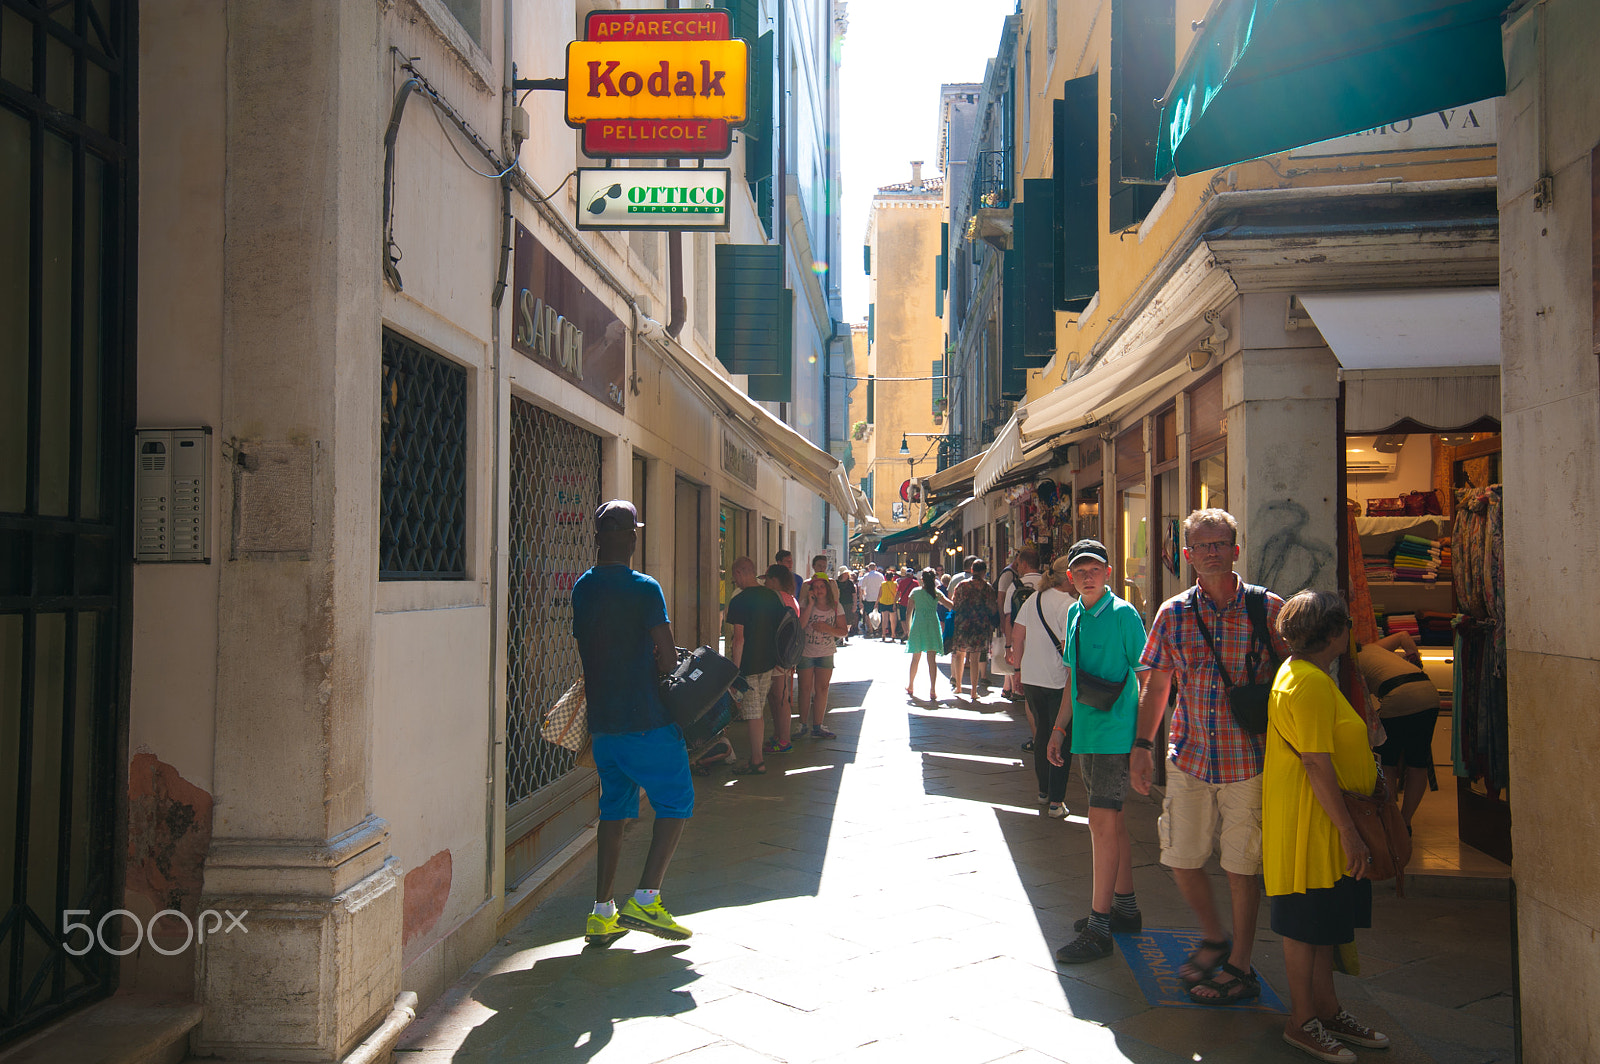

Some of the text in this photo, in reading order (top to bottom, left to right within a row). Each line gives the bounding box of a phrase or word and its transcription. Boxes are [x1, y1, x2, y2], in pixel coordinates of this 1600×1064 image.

[597, 21, 717, 37] APPARECCHI
[586, 60, 726, 98] Kodak
[603, 125, 708, 140] PELLICOLE
[627, 186, 725, 204] OTTICO
[518, 288, 584, 381] SAPORI
[1131, 935, 1188, 996] FURNACE
